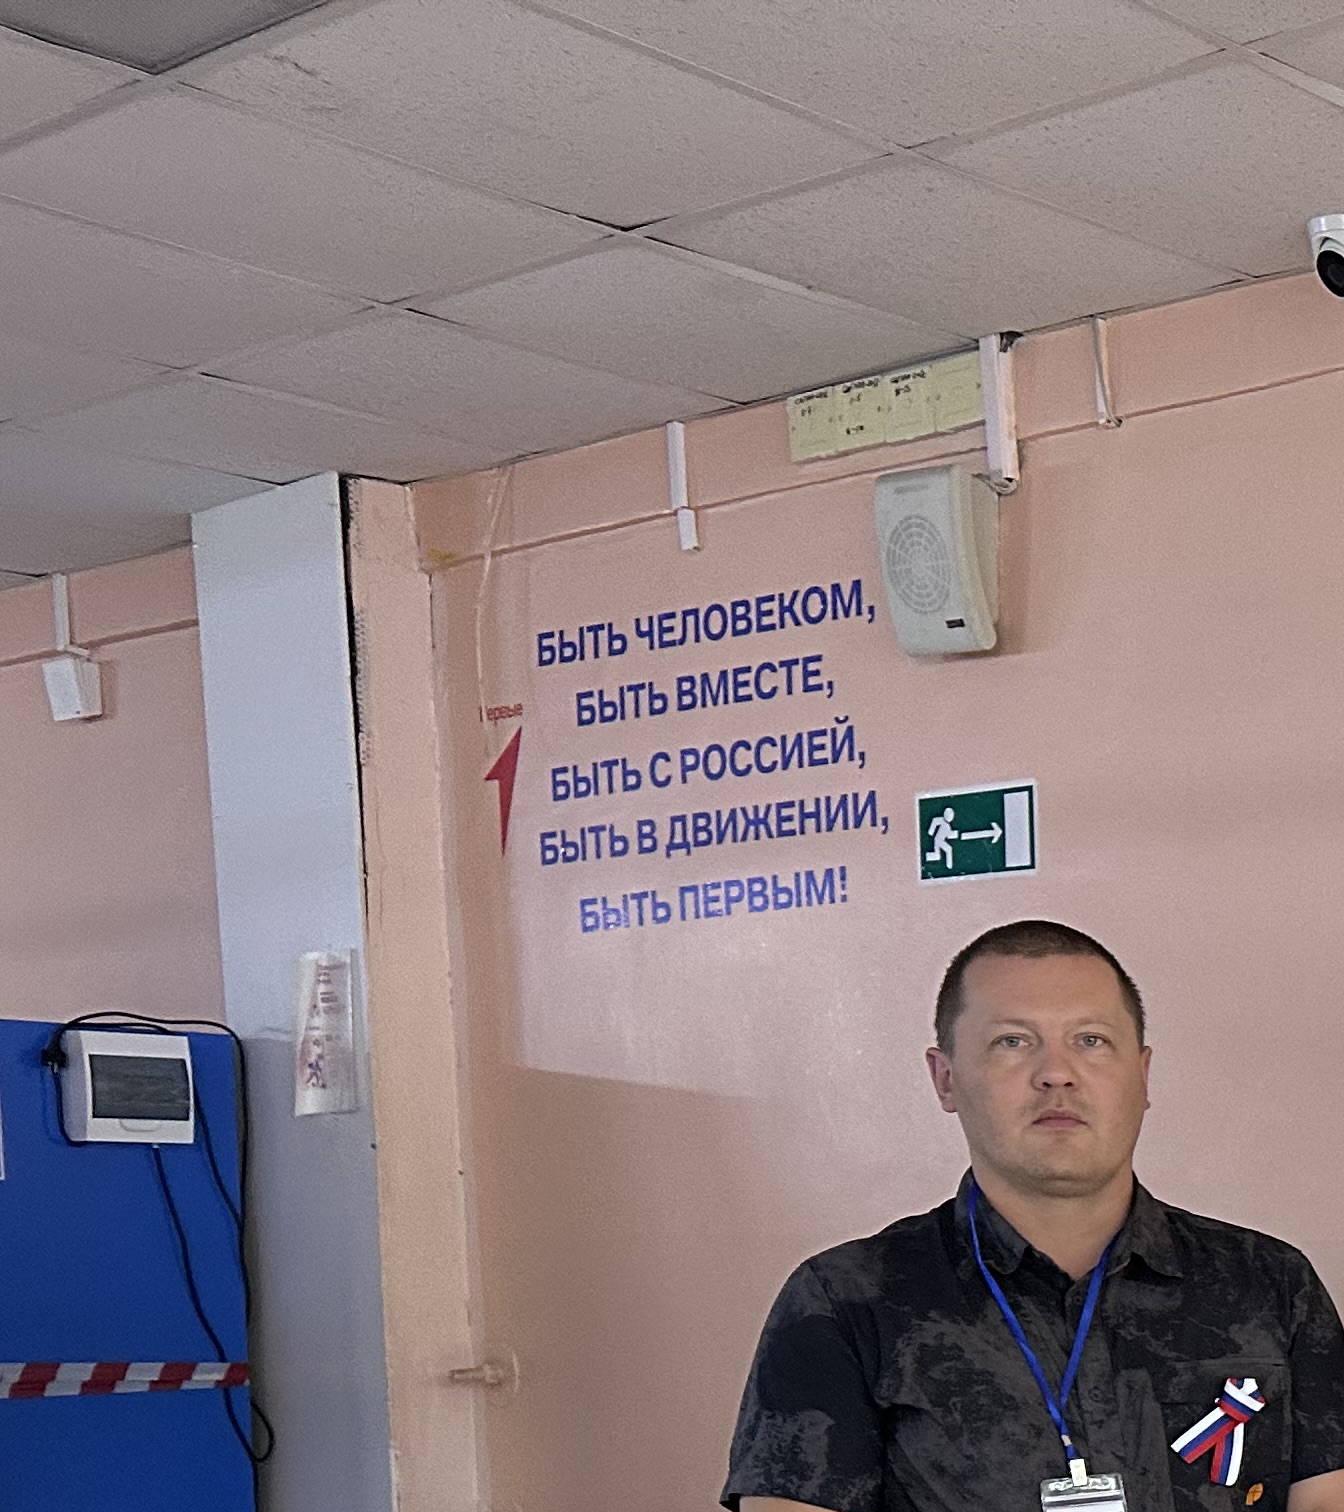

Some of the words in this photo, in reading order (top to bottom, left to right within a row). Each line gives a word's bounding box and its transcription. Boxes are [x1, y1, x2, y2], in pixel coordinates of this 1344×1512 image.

[537, 623, 627, 667] БЫТЬ
[634, 579, 876, 650] ЧЕЛОВЕКОМ,
[576, 682, 668, 726] БЫТЬ
[676, 655, 835, 712] ВМЕСТЕ,
[551, 759, 641, 802] БЫТЬ
[649, 751, 672, 788] С
[680, 716, 866, 784] РОССИЕЙ,
[540, 822, 629, 866] БЫТЬ
[637, 817, 657, 854] В
[665, 790, 889, 858] ДВИЖЕНИИ,
[580, 889, 671, 933] БЫТЬ
[679, 866, 848, 921] ПЕРВЫМ!
